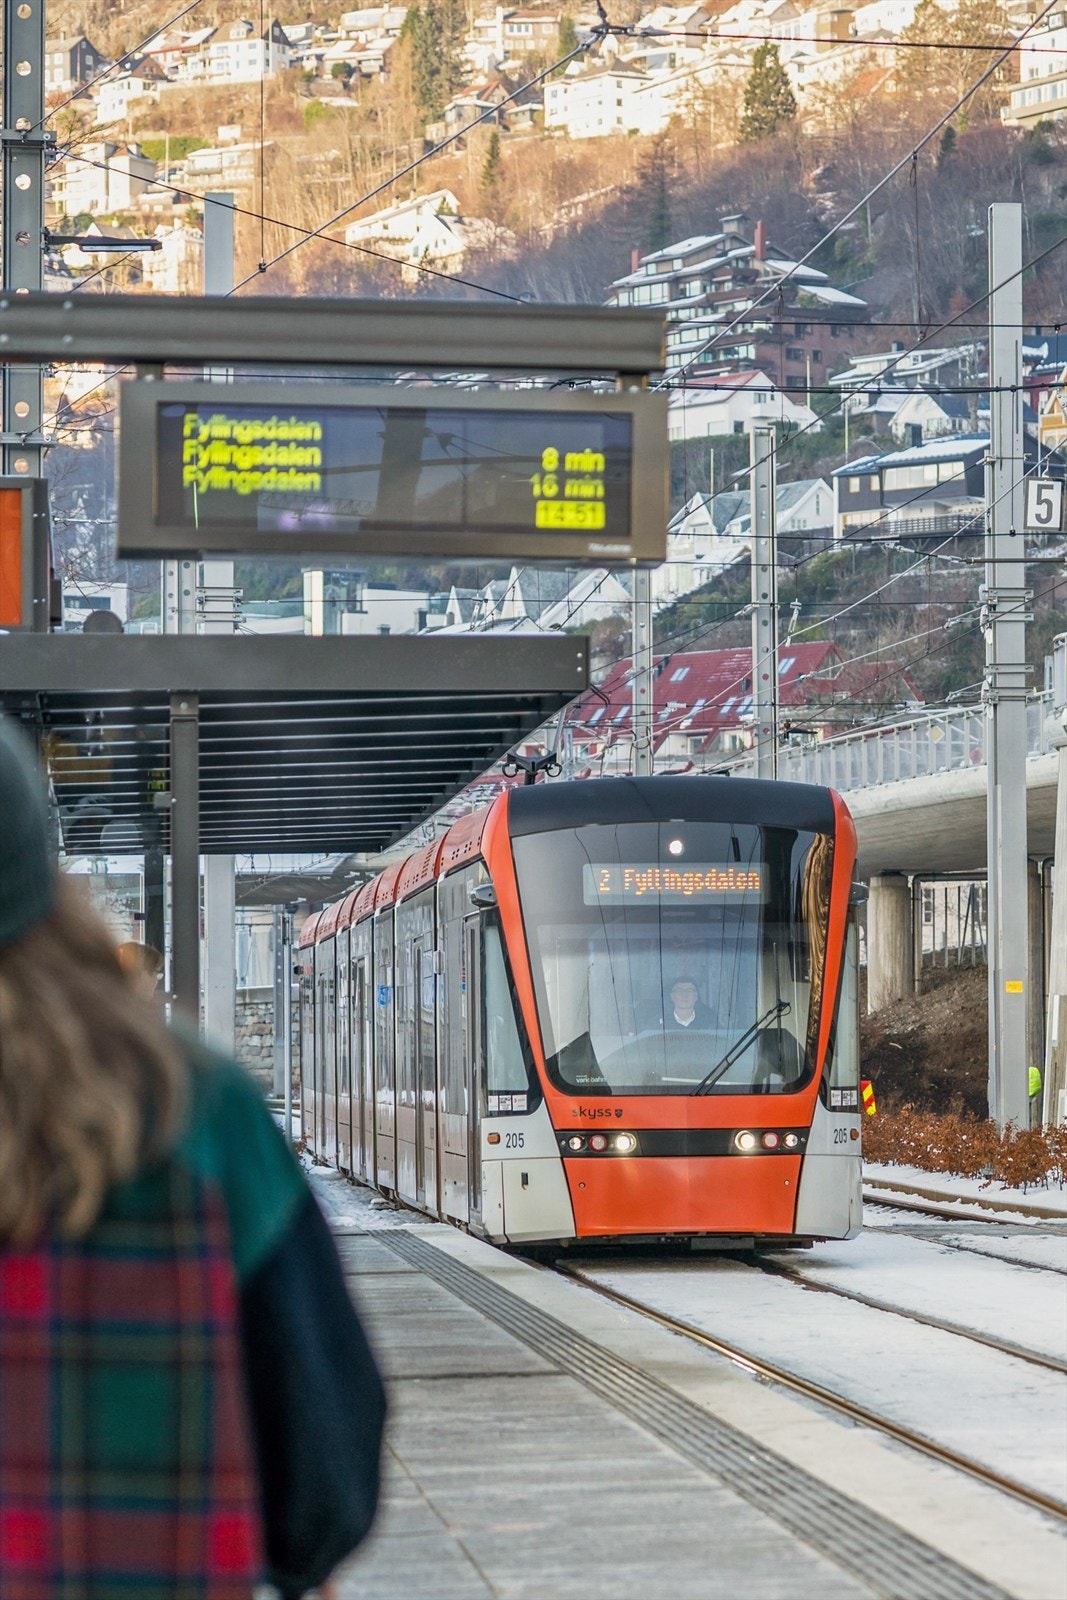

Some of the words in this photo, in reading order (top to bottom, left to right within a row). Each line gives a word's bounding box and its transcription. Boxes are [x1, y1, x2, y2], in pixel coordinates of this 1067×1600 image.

[183, 438, 322, 470] Fyllingsdalen
[542, 447, 559, 472] 8
[564, 448, 605, 472] min
[530, 472, 559, 497] 16
[564, 474, 605, 498] min
[1035, 484, 1054, 525] 5
[599, 869, 610, 891] 2
[624, 868, 760, 895] Fyllingsdalen
[572, 1106, 612, 1119] skyss
[505, 1132, 525, 1148] 205
[833, 1128, 848, 1144] 205
